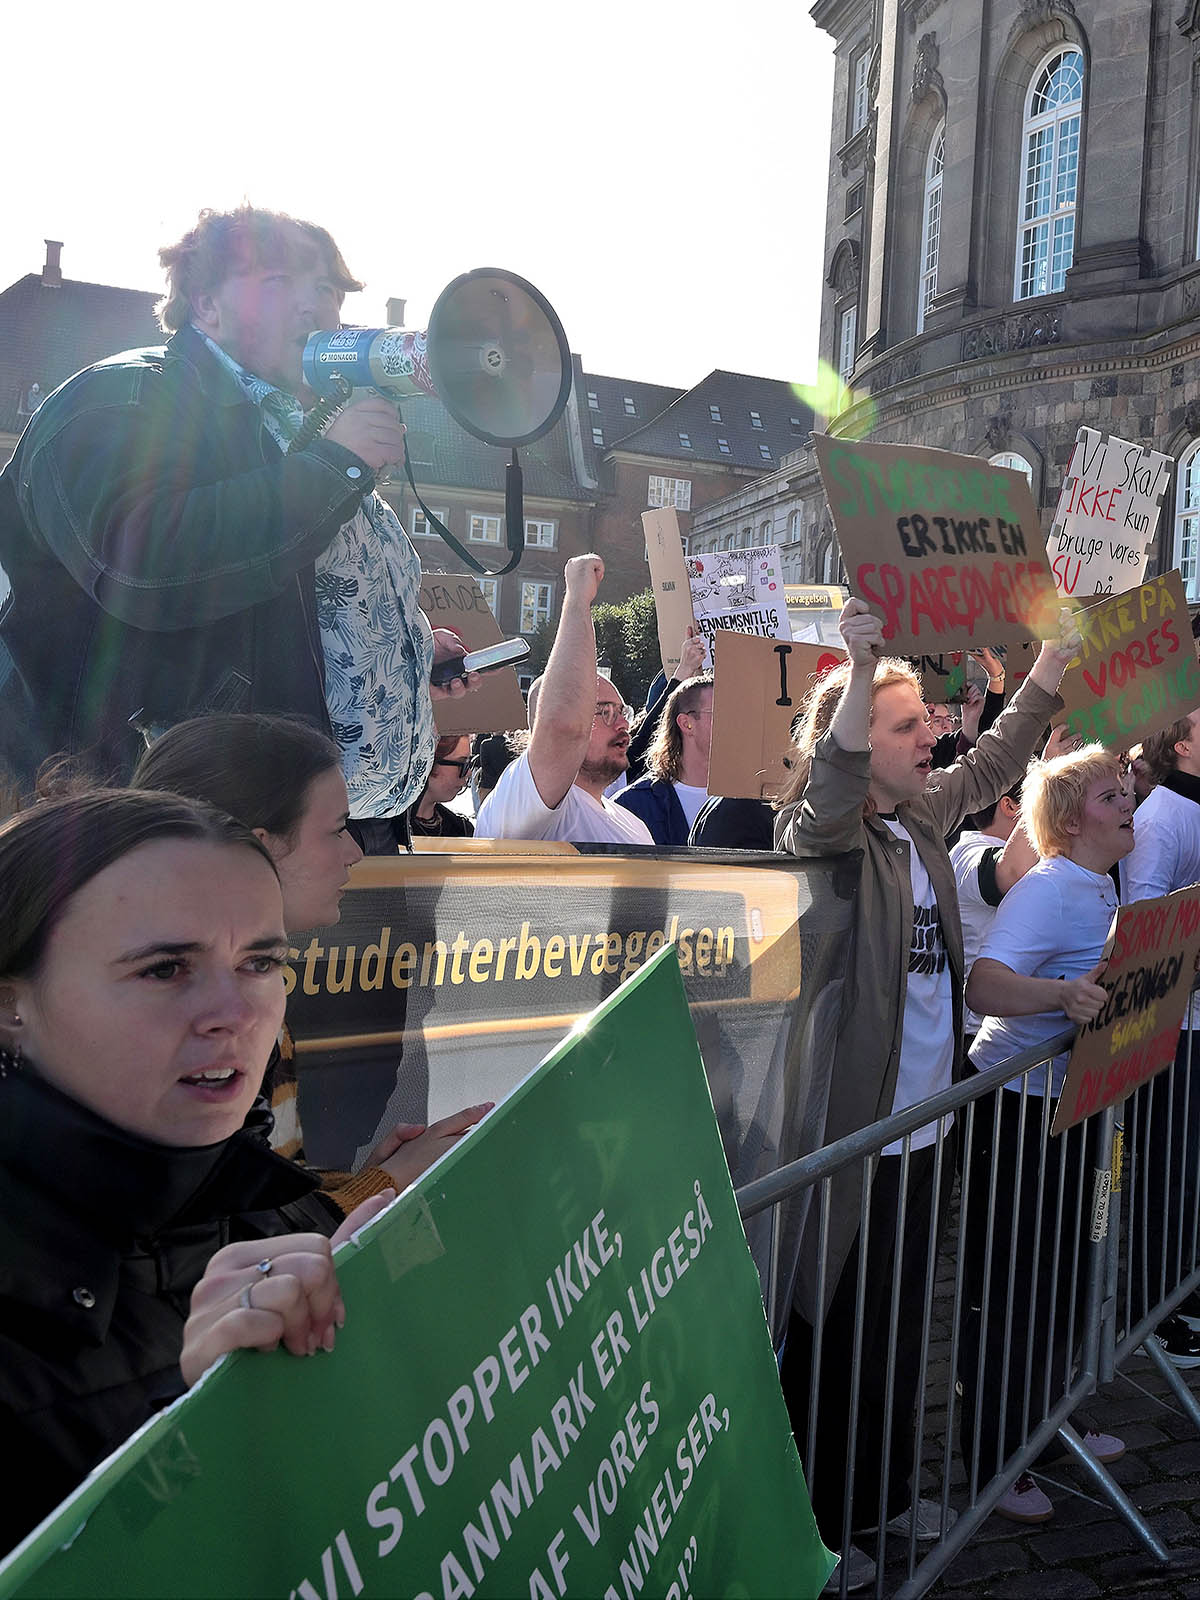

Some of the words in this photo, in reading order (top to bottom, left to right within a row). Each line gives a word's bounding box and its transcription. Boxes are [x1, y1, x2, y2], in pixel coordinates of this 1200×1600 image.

[328, 353, 357, 361] MONACOR
[897, 514, 935, 557] ER
[932, 516, 996, 555] IKKE
[996, 518, 1028, 556] EN
[1066, 477, 1123, 521] IKKE
[1124, 497, 1150, 534] kun
[1058, 518, 1103, 565] bruge
[1110, 542, 1140, 567] vores
[1052, 555, 1082, 594] SU
[1140, 578, 1177, 623] PÅ
[774, 644, 793, 707] I
[1082, 619, 1181, 697] VORES
[1067, 656, 1199, 747] REGNING
[1109, 905, 1169, 968] SORRY
[1096, 1211, 1104, 1220] 20
[366, 1304, 552, 1558] STOPPER
[546, 1208, 623, 1329] IKKE,
[413, 1363, 596, 1600] ANMARK
[591, 1310, 632, 1390] ER
[627, 1180, 714, 1333] LIGESÅ
[573, 1381, 660, 1547] VORES
